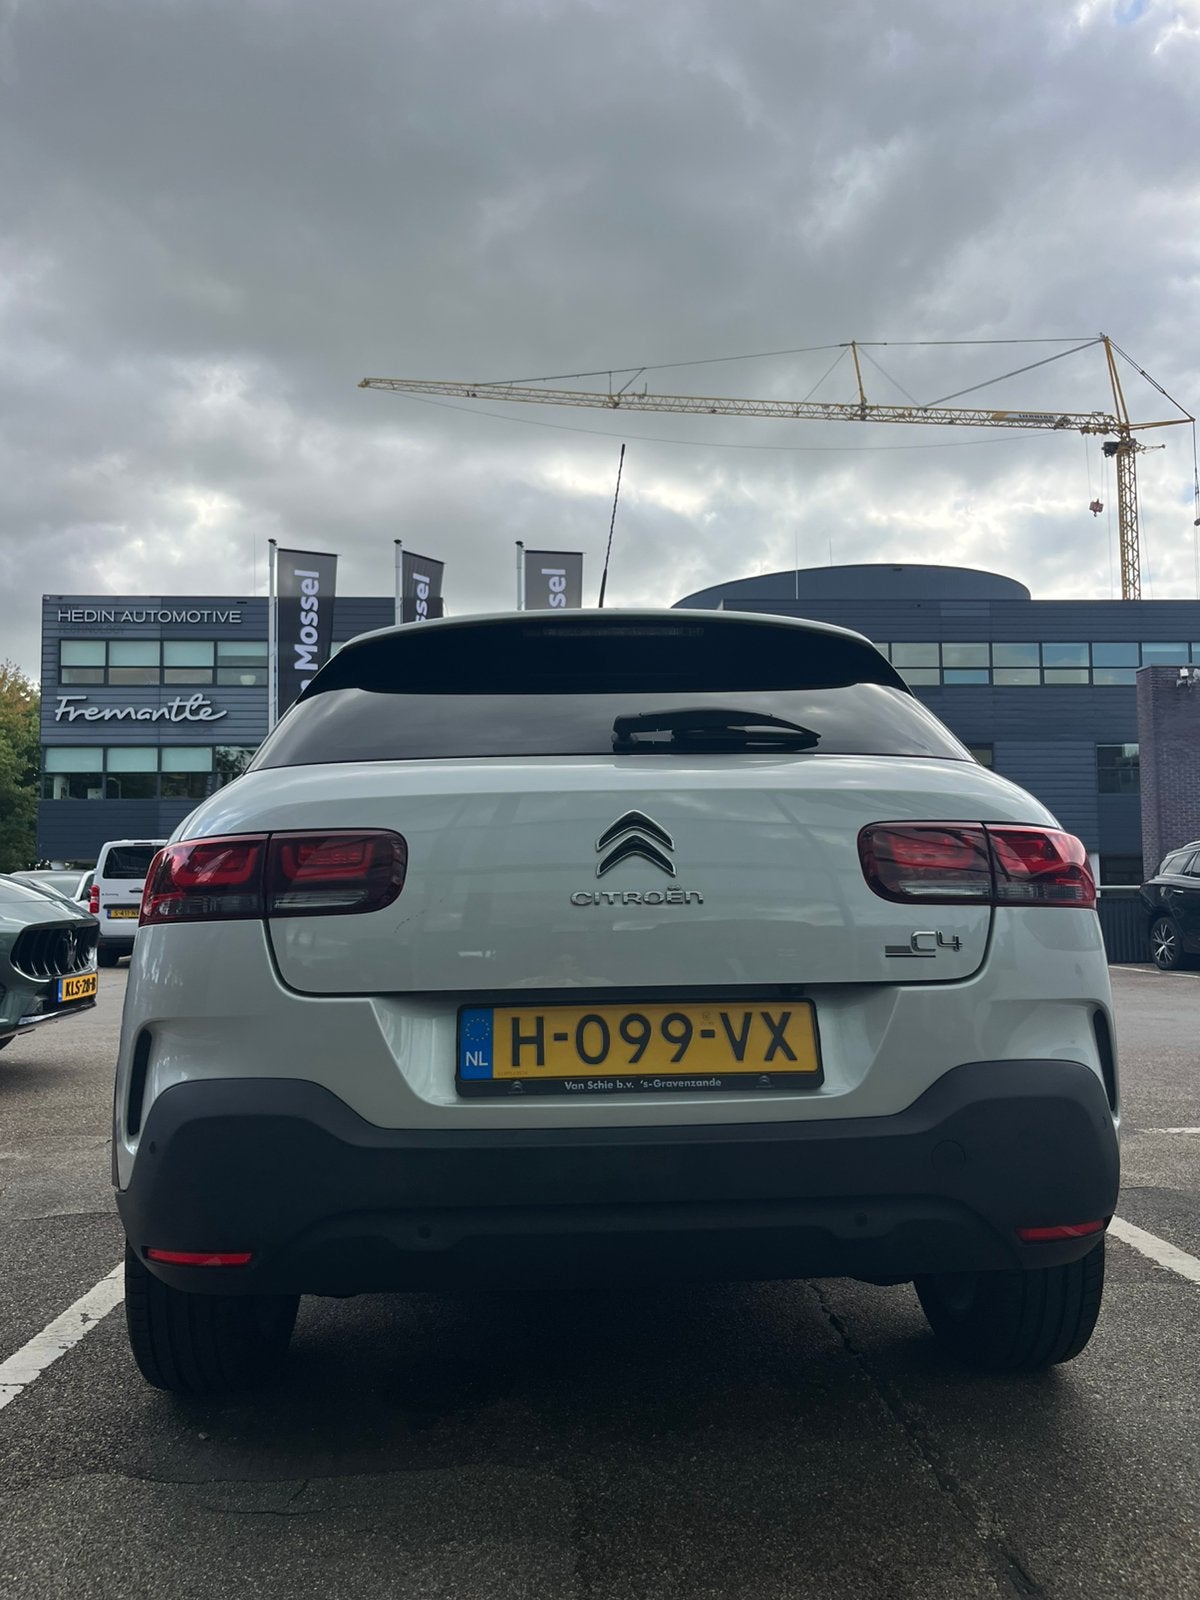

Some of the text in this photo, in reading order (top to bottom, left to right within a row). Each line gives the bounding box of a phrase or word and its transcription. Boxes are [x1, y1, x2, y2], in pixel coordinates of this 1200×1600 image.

[57, 609, 242, 624] HEDIN AUTOMOTIVE
[294, 569, 320, 671] Mossel
[55, 693, 228, 723] Fremantle
[910, 930, 963, 954] C4
[511, 1011, 798, 1067] H-099-VX
[465, 1050, 489, 1067] NL
[564, 1077, 722, 1091] Van Schie b.v. 's-Gravenzande
